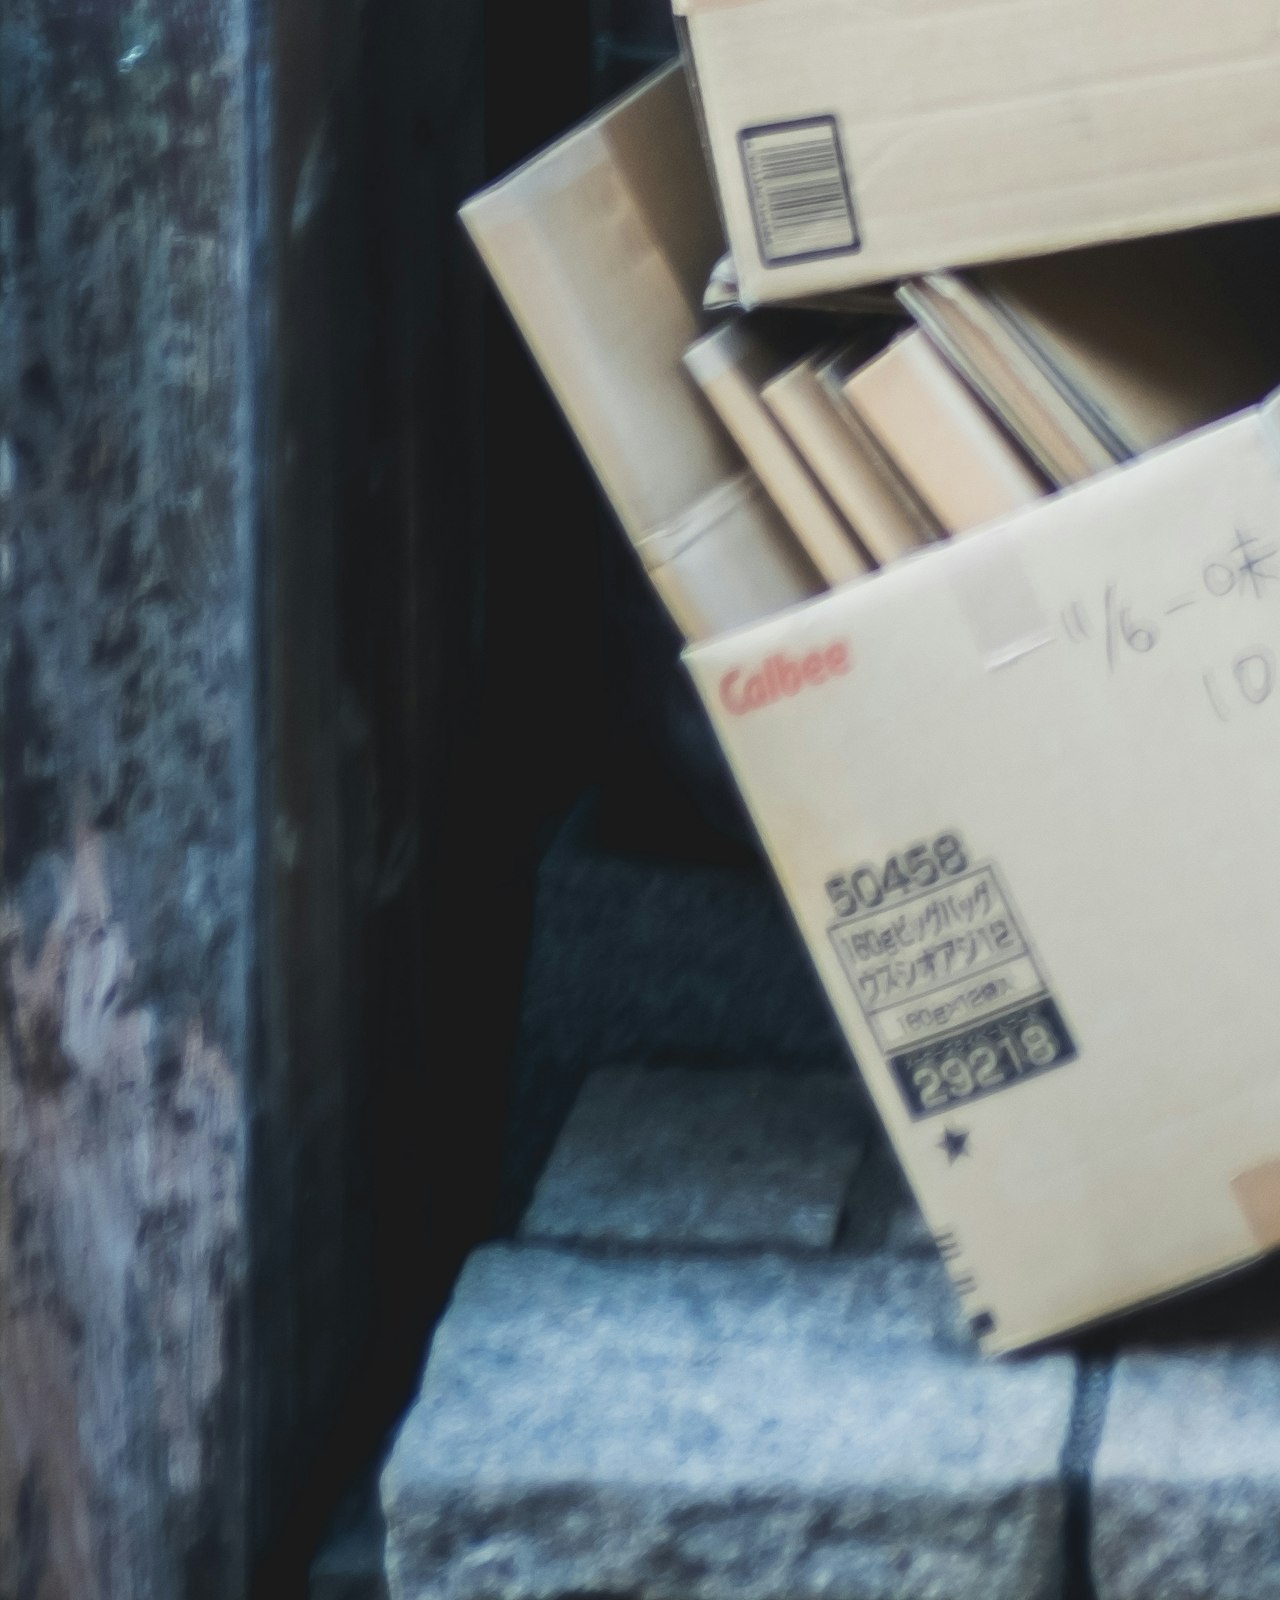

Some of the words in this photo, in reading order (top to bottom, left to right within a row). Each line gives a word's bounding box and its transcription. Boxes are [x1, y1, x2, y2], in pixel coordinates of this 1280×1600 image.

[717, 638, 855, 719] Calbee
[824, 828, 971, 919] 50458
[912, 1022, 1060, 1114] 29218
